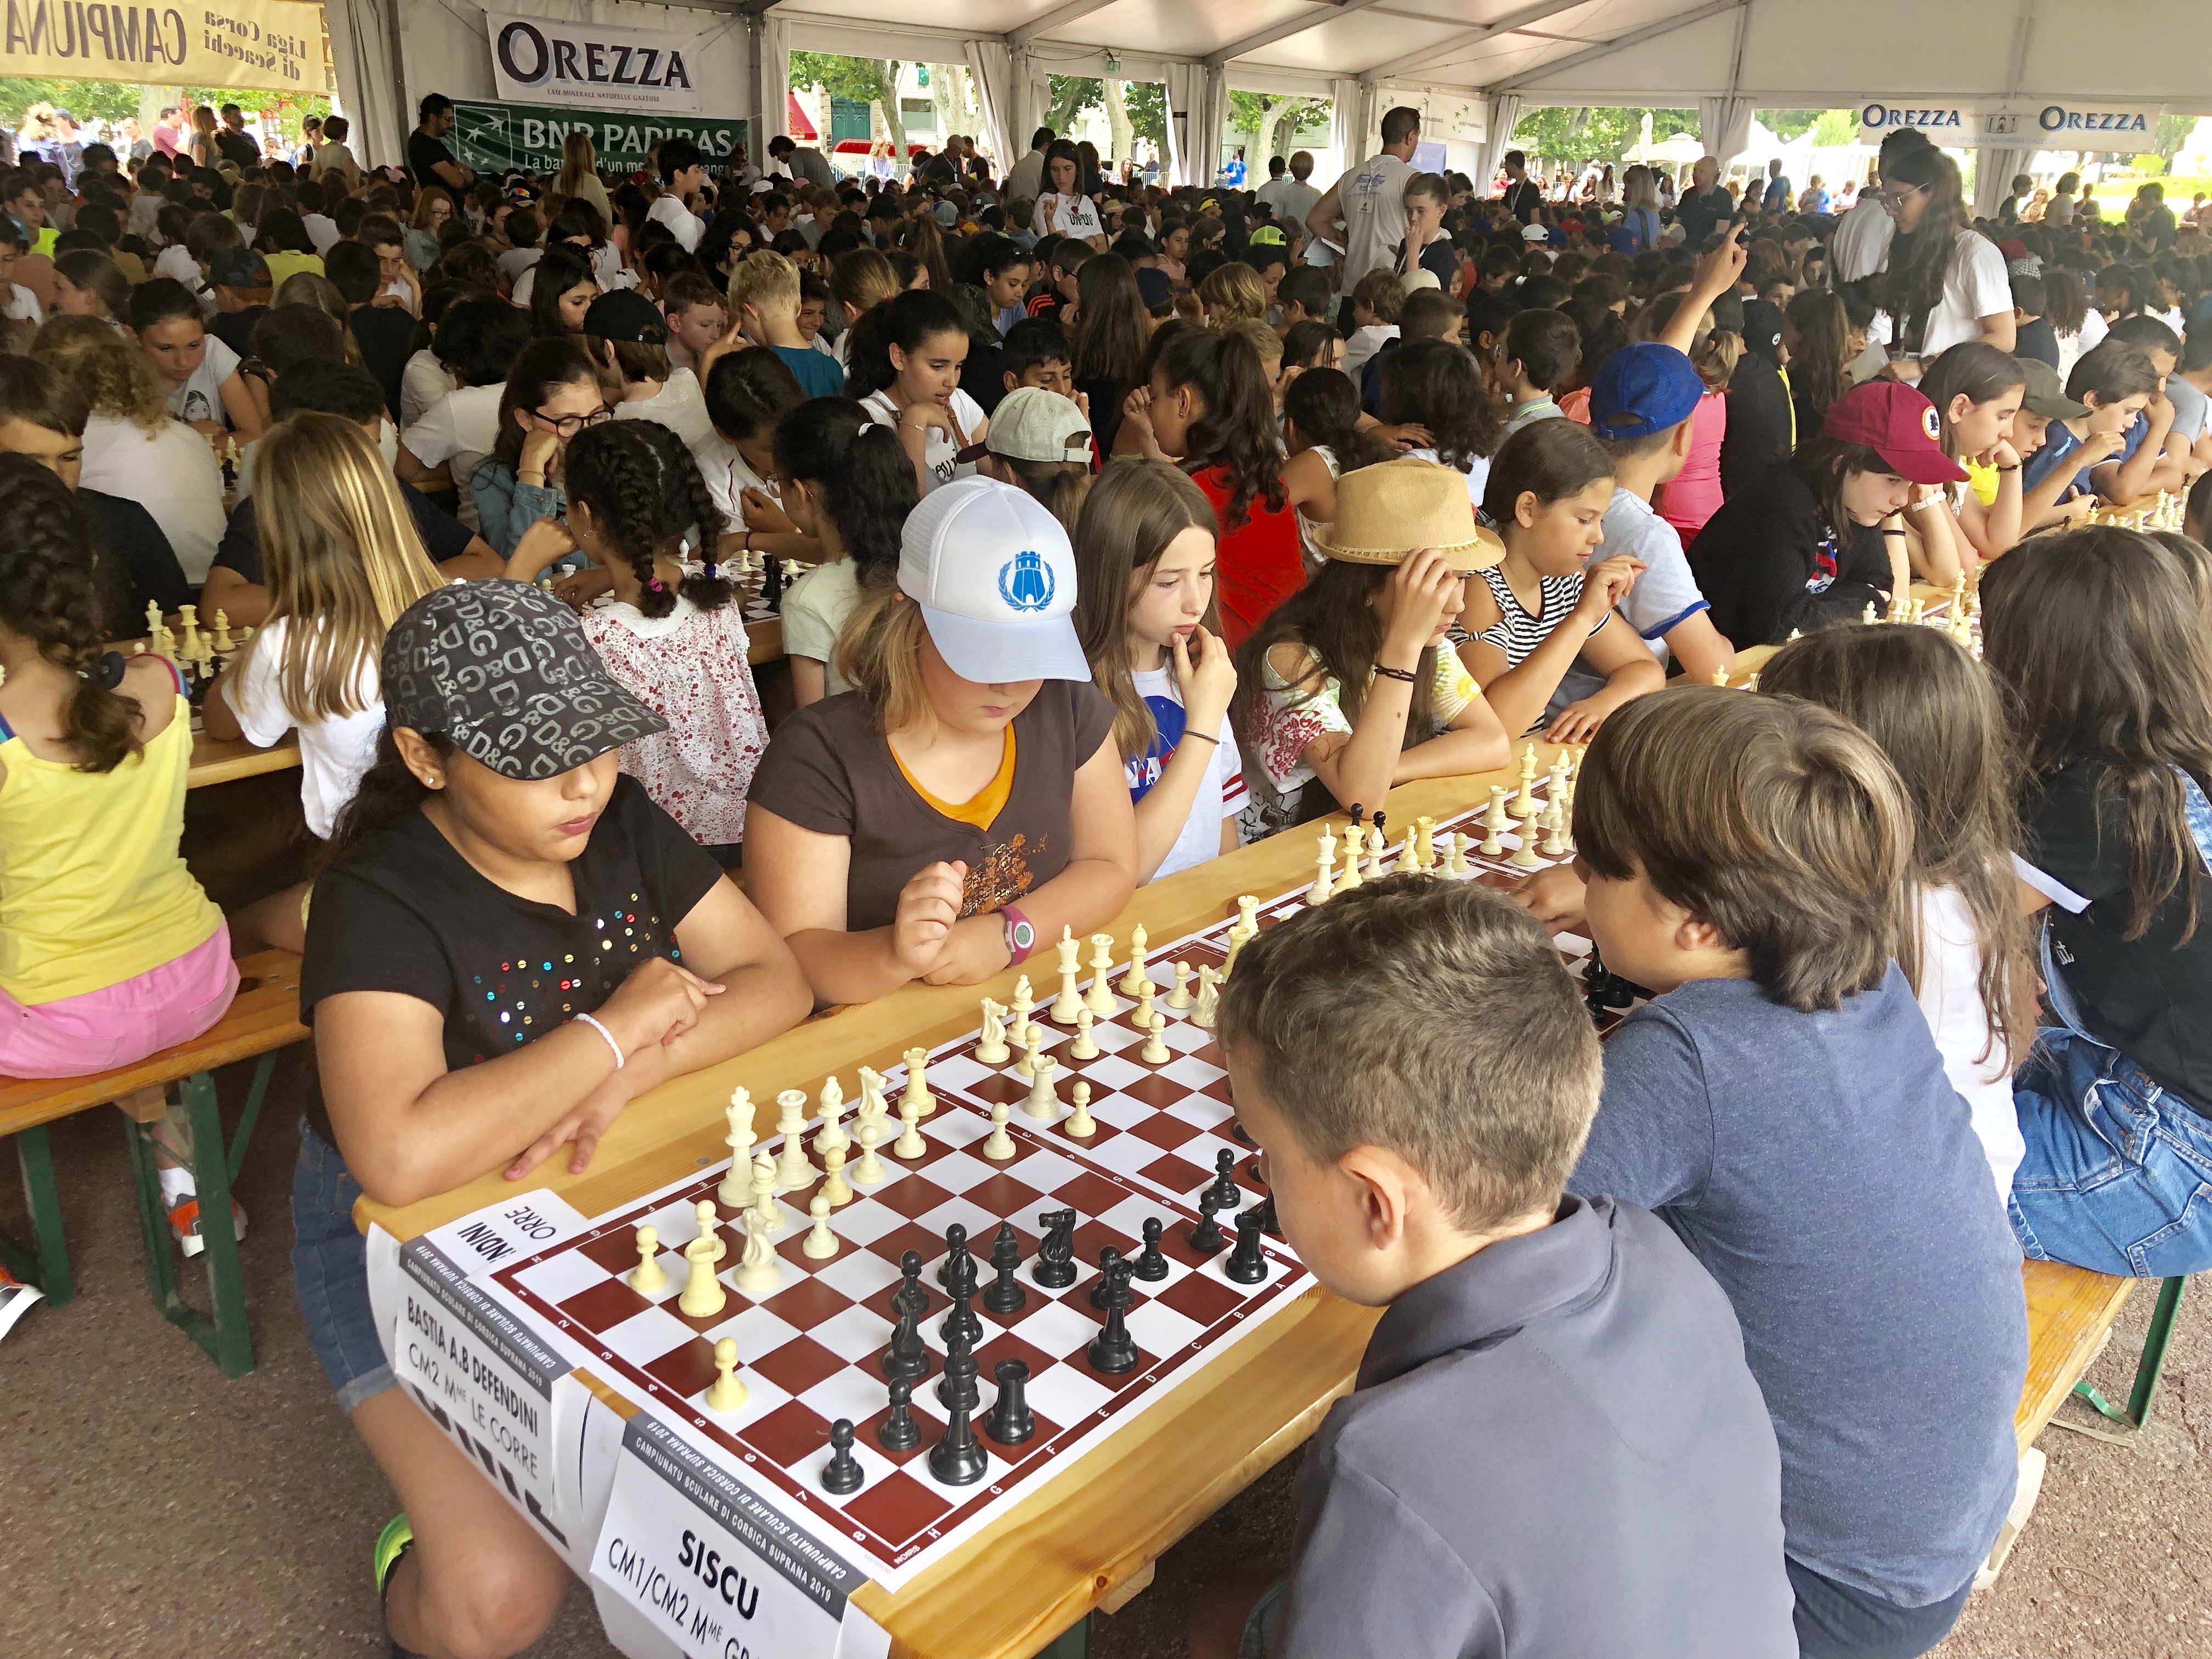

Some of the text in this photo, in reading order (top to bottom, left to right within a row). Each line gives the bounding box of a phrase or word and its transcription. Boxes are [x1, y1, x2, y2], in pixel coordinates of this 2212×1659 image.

[498, 22, 694, 91] OREZZA
[1862, 104, 1962, 129] OREZZA
[2039, 106, 2148, 132] OREZZA
[523, 119, 594, 149] BNP
[525, 154, 541, 169] La
[597, 157, 623, 172] d'un
[456, 600, 498, 657] D&G
[457, 646, 532, 692] D&G
[457, 1221, 517, 1263] NDINI
[416, 1245, 556, 1368] CAMPIUNATU SCULARE DI CORSICA SUPRANA 2019
[1233, 1311, 1245, 1319] B
[407, 1258, 542, 1387] CAMPIUNATU SCULARE DI CORSICA SUPRANA 2019
[558, 1319, 571, 1328] 2
[601, 1351, 613, 1360] 3
[1191, 1341, 1203, 1350] C
[408, 1295, 445, 1354] BASTIA
[450, 1337, 469, 1374] A.B
[472, 1355, 538, 1437] DEFENDINI
[648, 1383, 658, 1392] 4
[409, 1342, 439, 1387] CM2
[471, 1397, 486, 1430] LE
[490, 1417, 537, 1480] CORRE
[695, 1417, 707, 1427] 5
[1097, 1407, 1110, 1419] E
[647, 1421, 670, 1438] 2019
[666, 1436, 706, 1468] SUPRANA
[1047, 1444, 1057, 1455] F
[702, 1464, 741, 1496] CORSICA
[990, 1485, 1003, 1495] G
[737, 1493, 752, 1504] DI
[796, 1490, 808, 1502] 7
[636, 1437, 832, 1602] CAMPIUNATU SCULARE DI CORSICA SUPRANA 2019
[748, 1501, 791, 1534] SCULARE
[853, 1531, 866, 1542] 8
[927, 1528, 942, 1539] H
[787, 1532, 847, 1580] CAMPIUNATU
[893, 1544, 921, 1565] NOIRS
[608, 1537, 689, 1627] CM1/CM2
[678, 1528, 760, 1620] SISCU
